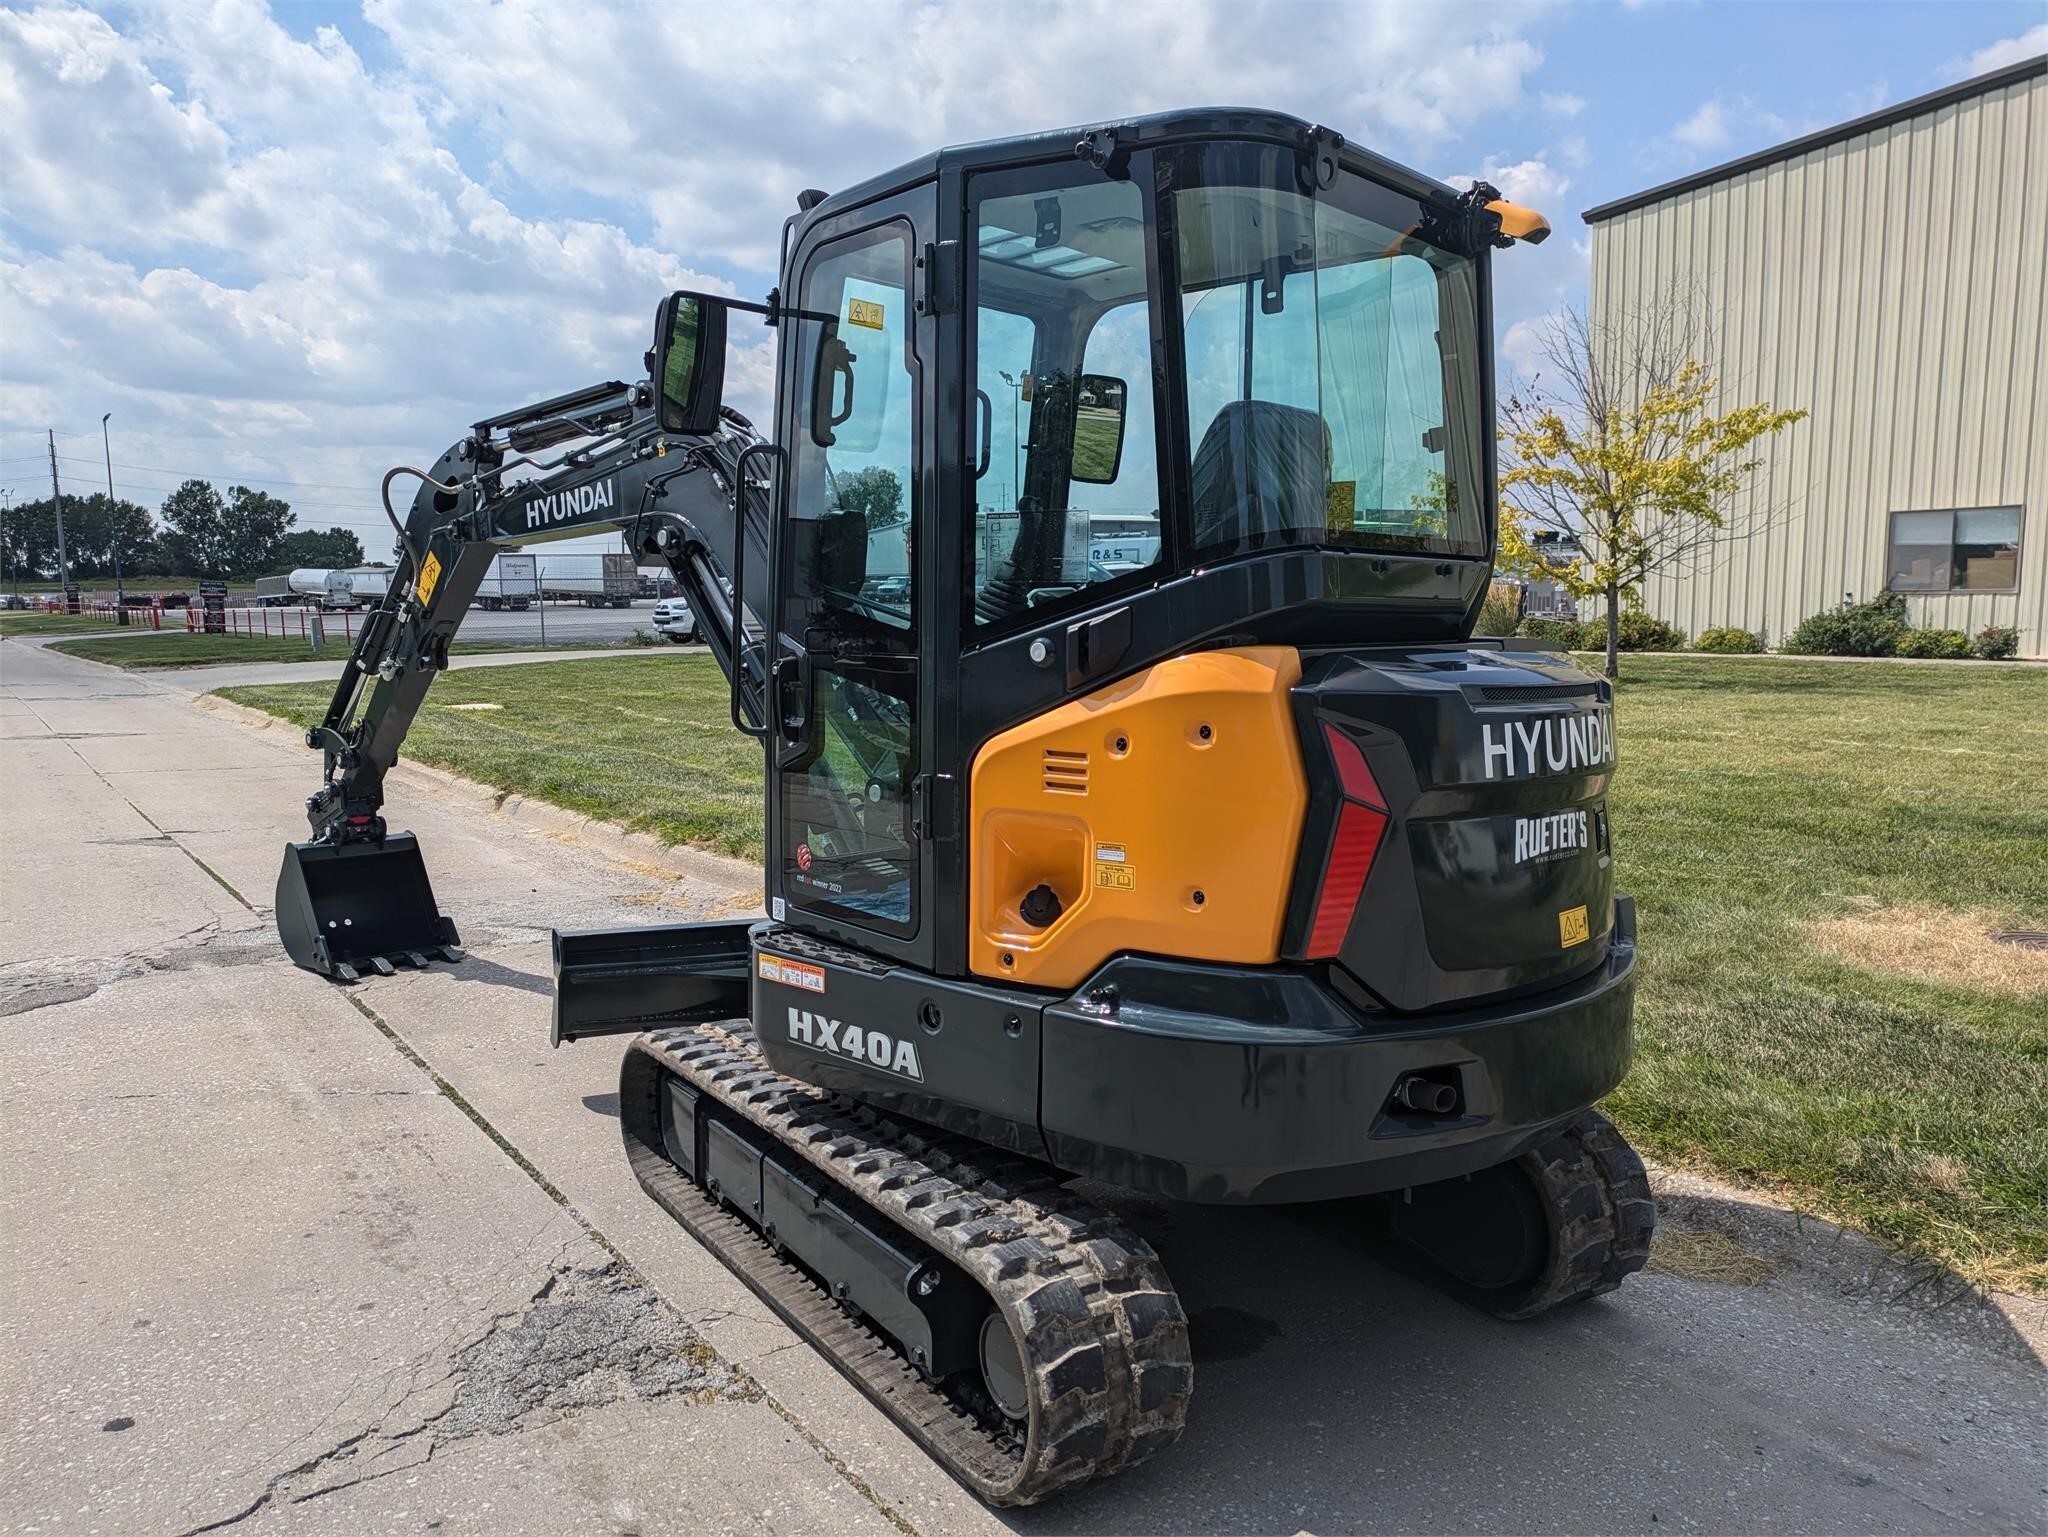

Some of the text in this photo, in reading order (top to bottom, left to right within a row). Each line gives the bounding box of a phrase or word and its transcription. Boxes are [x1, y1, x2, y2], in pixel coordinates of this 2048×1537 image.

[526, 478, 614, 528] HYUNDAI
[1092, 548, 1123, 560] R & S
[1483, 713, 1615, 779] HYUNDAI
[1515, 810, 1588, 865] RUETER'S
[812, 878, 829, 890] winner
[829, 882, 842, 893] 2022
[788, 1007, 920, 1079] HX40A
